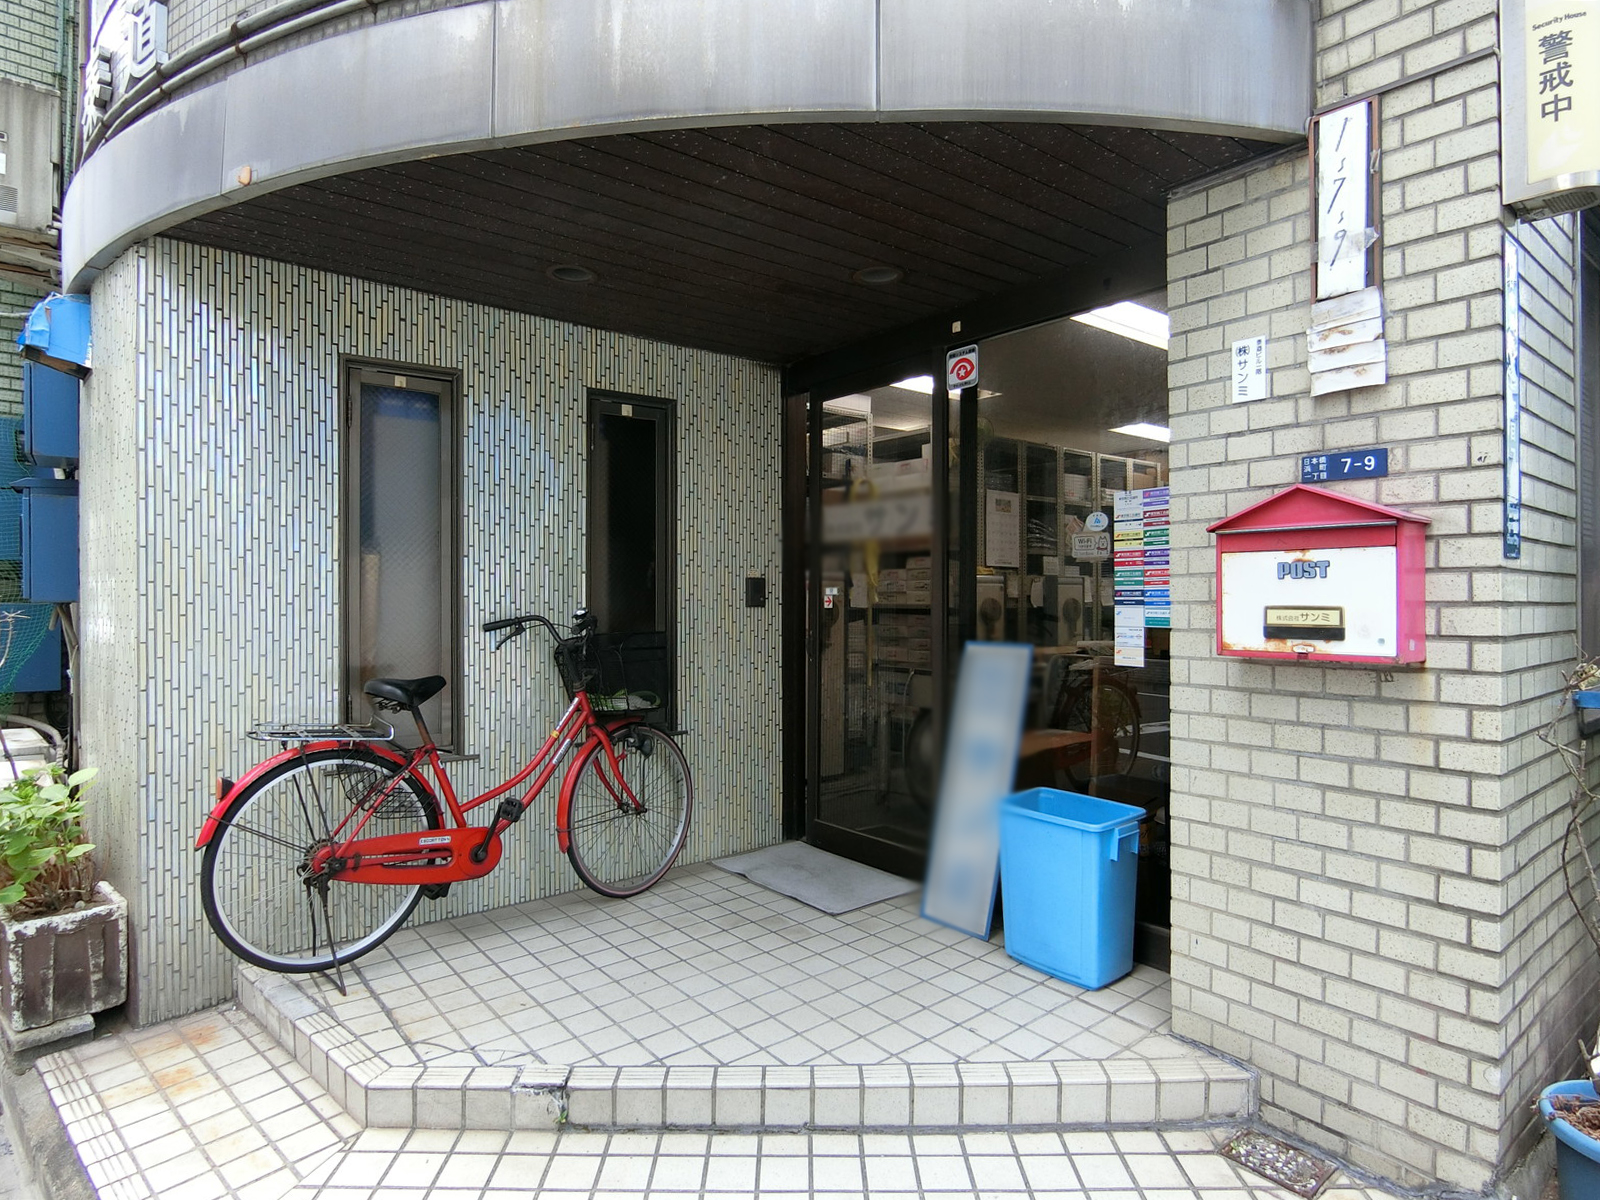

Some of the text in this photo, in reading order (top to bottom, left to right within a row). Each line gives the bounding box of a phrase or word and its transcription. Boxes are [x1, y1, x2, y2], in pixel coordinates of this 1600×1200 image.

[1532, 11, 1587, 31] Security House
[1539, 30, 1573, 122] 警戒中
[1303, 456, 1326, 465] 日本橋
[1340, 455, 1375, 473] 7-9
[1304, 472, 1327, 480] 一丁目
[1277, 560, 1330, 580] POST
